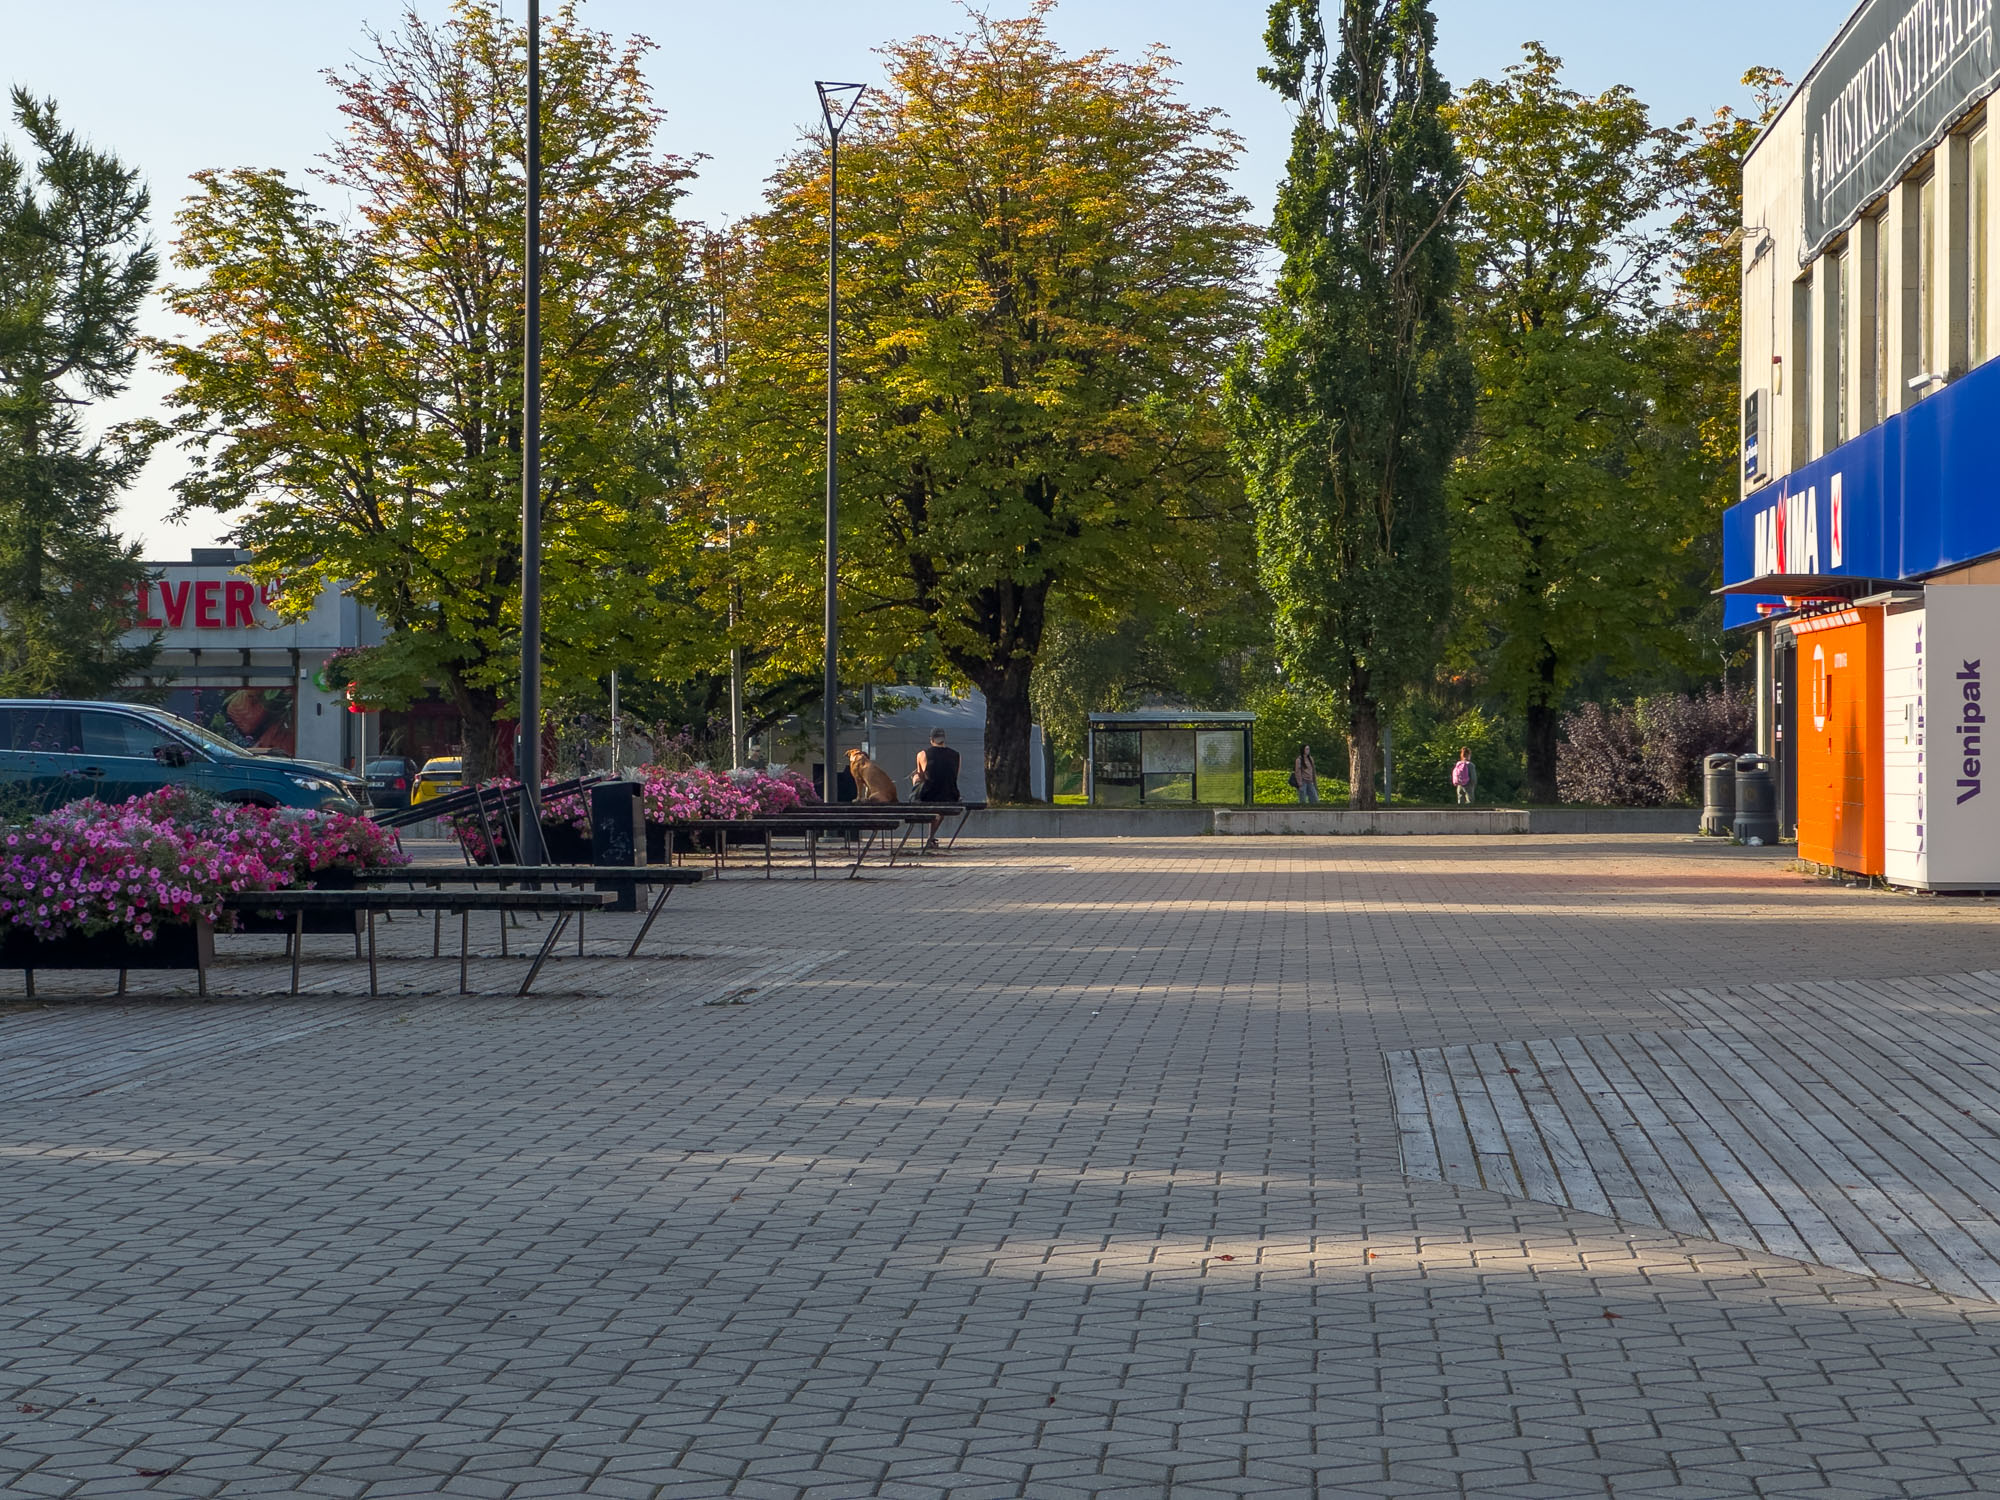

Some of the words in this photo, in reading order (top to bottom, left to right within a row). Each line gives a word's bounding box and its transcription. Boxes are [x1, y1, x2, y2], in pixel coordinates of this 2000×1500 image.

[1821, 0, 1993, 190] MUSTKUNSTITEA
[1754, 479, 1819, 577] MAXIMA
[78, 580, 256, 629] LVER
[1956, 658, 1986, 806] Venipak
